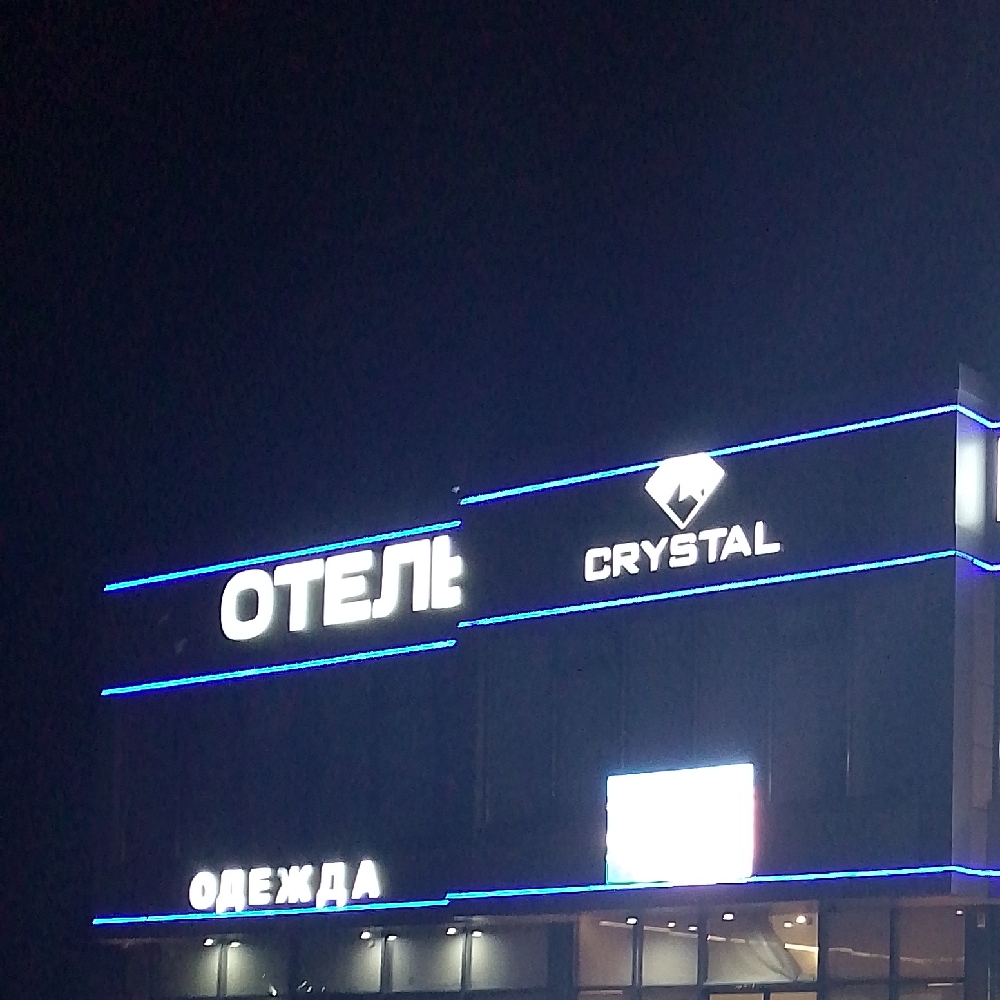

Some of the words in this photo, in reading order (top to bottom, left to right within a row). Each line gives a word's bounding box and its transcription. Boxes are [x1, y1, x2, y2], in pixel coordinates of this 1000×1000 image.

[584, 520, 781, 582] CRYSTAL
[220, 534, 463, 641] ОТЕЛЬ
[188, 860, 380, 914] ОДЕЖДА
